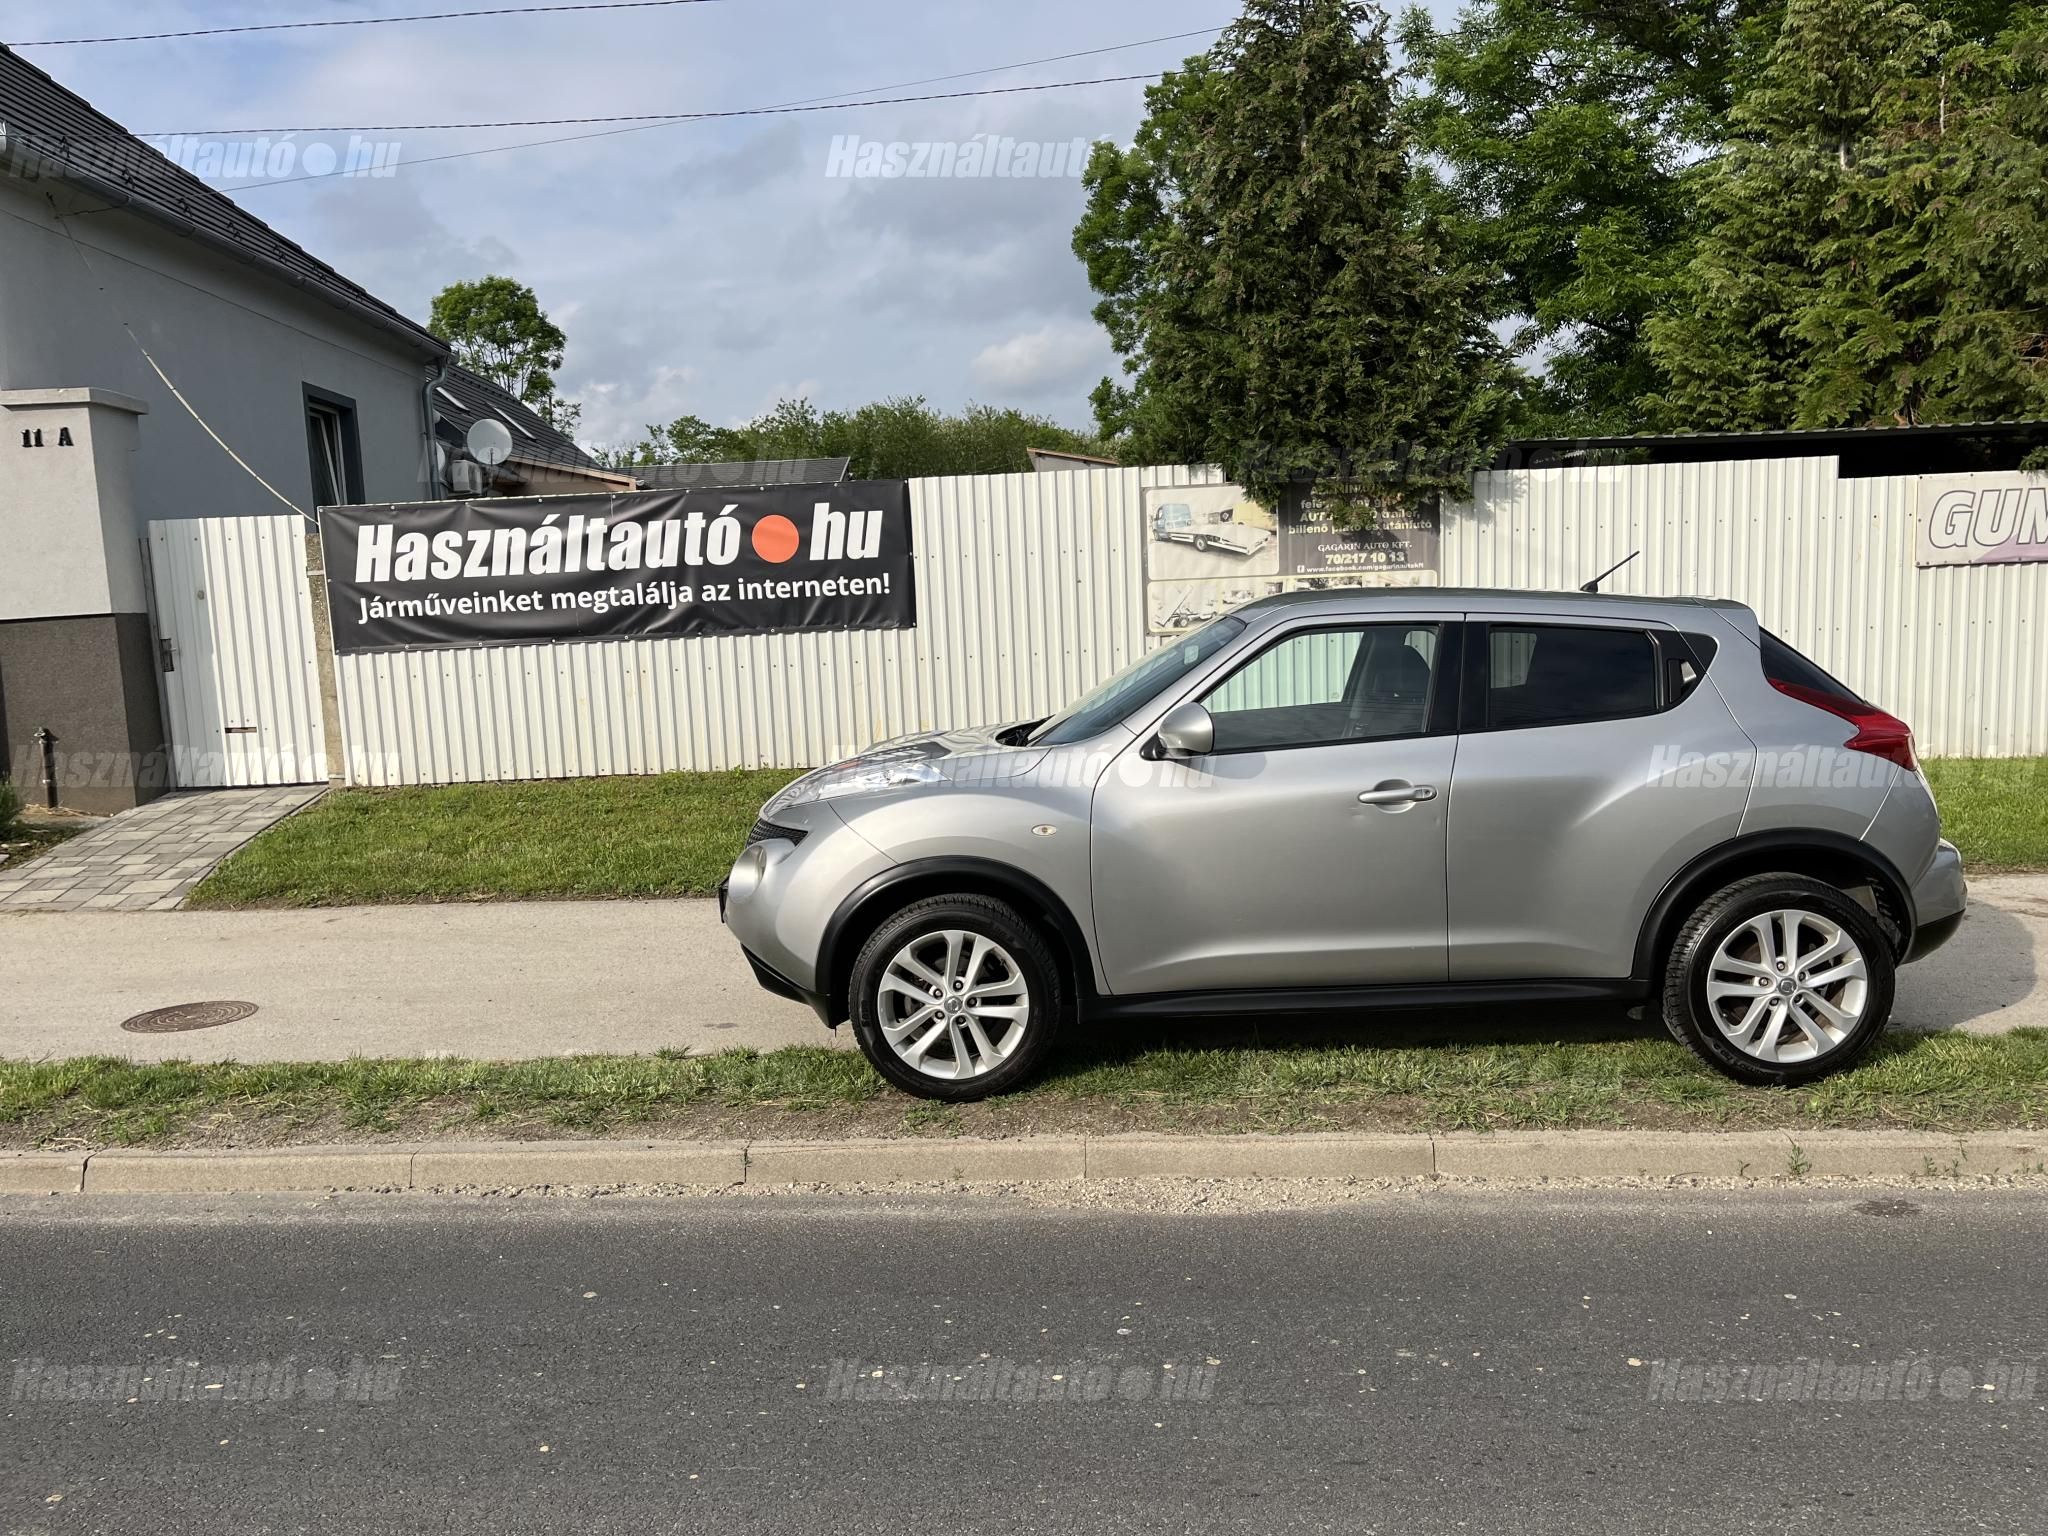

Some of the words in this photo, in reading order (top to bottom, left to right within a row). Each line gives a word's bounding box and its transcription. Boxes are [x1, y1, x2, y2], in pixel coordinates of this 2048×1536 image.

[22, 428, 44, 447] 11
[58, 427, 74, 446] A
[355, 504, 741, 583] Használtautó
[809, 502, 883, 561] hu
[1317, 543, 1361, 552] GAGARIN
[1325, 552, 1367, 564] 70/217
[1370, 552, 1386, 562] 10
[1389, 551, 1404, 561] 13
[358, 590, 544, 624] Járműveinket
[552, 580, 693, 613] megtalálja
[702, 583, 731, 601] az
[738, 572, 890, 600] interneten!
